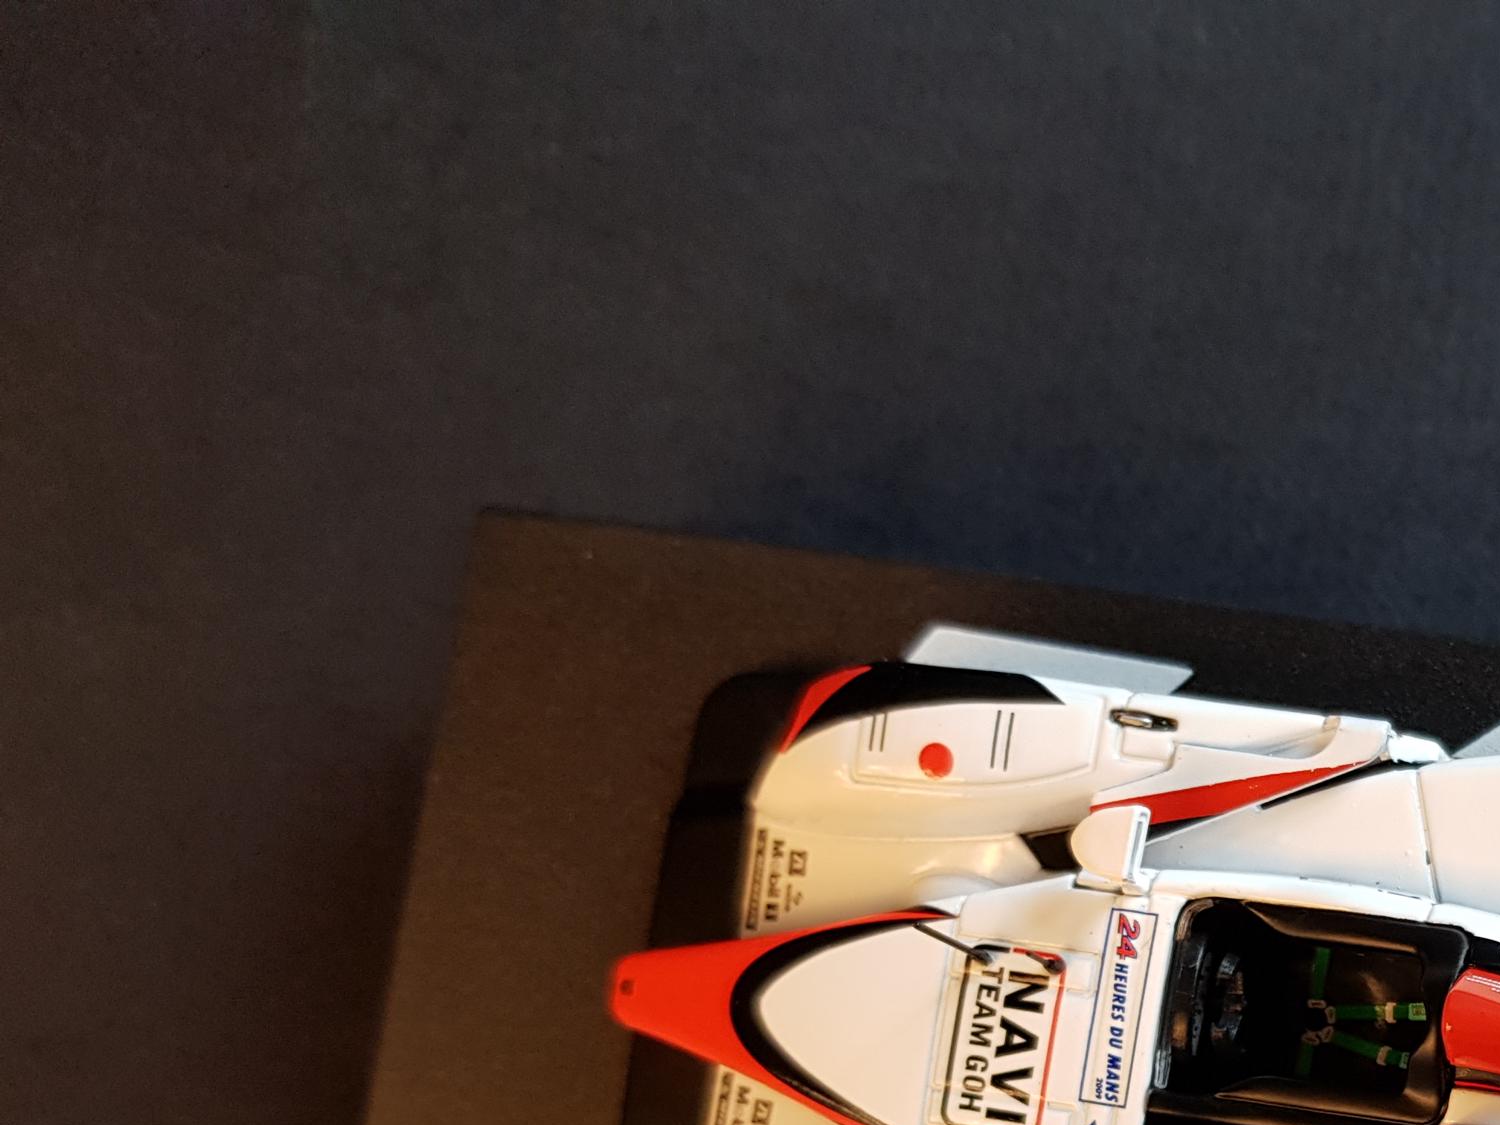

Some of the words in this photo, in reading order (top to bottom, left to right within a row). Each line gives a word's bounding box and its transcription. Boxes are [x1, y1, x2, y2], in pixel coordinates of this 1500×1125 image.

[1115, 913, 1140, 960] 24
[968, 966, 1006, 1048] TEAM
[1110, 963, 1129, 1022] HEURES
[984, 970, 1050, 1125] NAVI
[1108, 1024, 1125, 1051] DU
[958, 1054, 990, 1113] GOH
[1104, 1049, 1122, 1104] MANS
